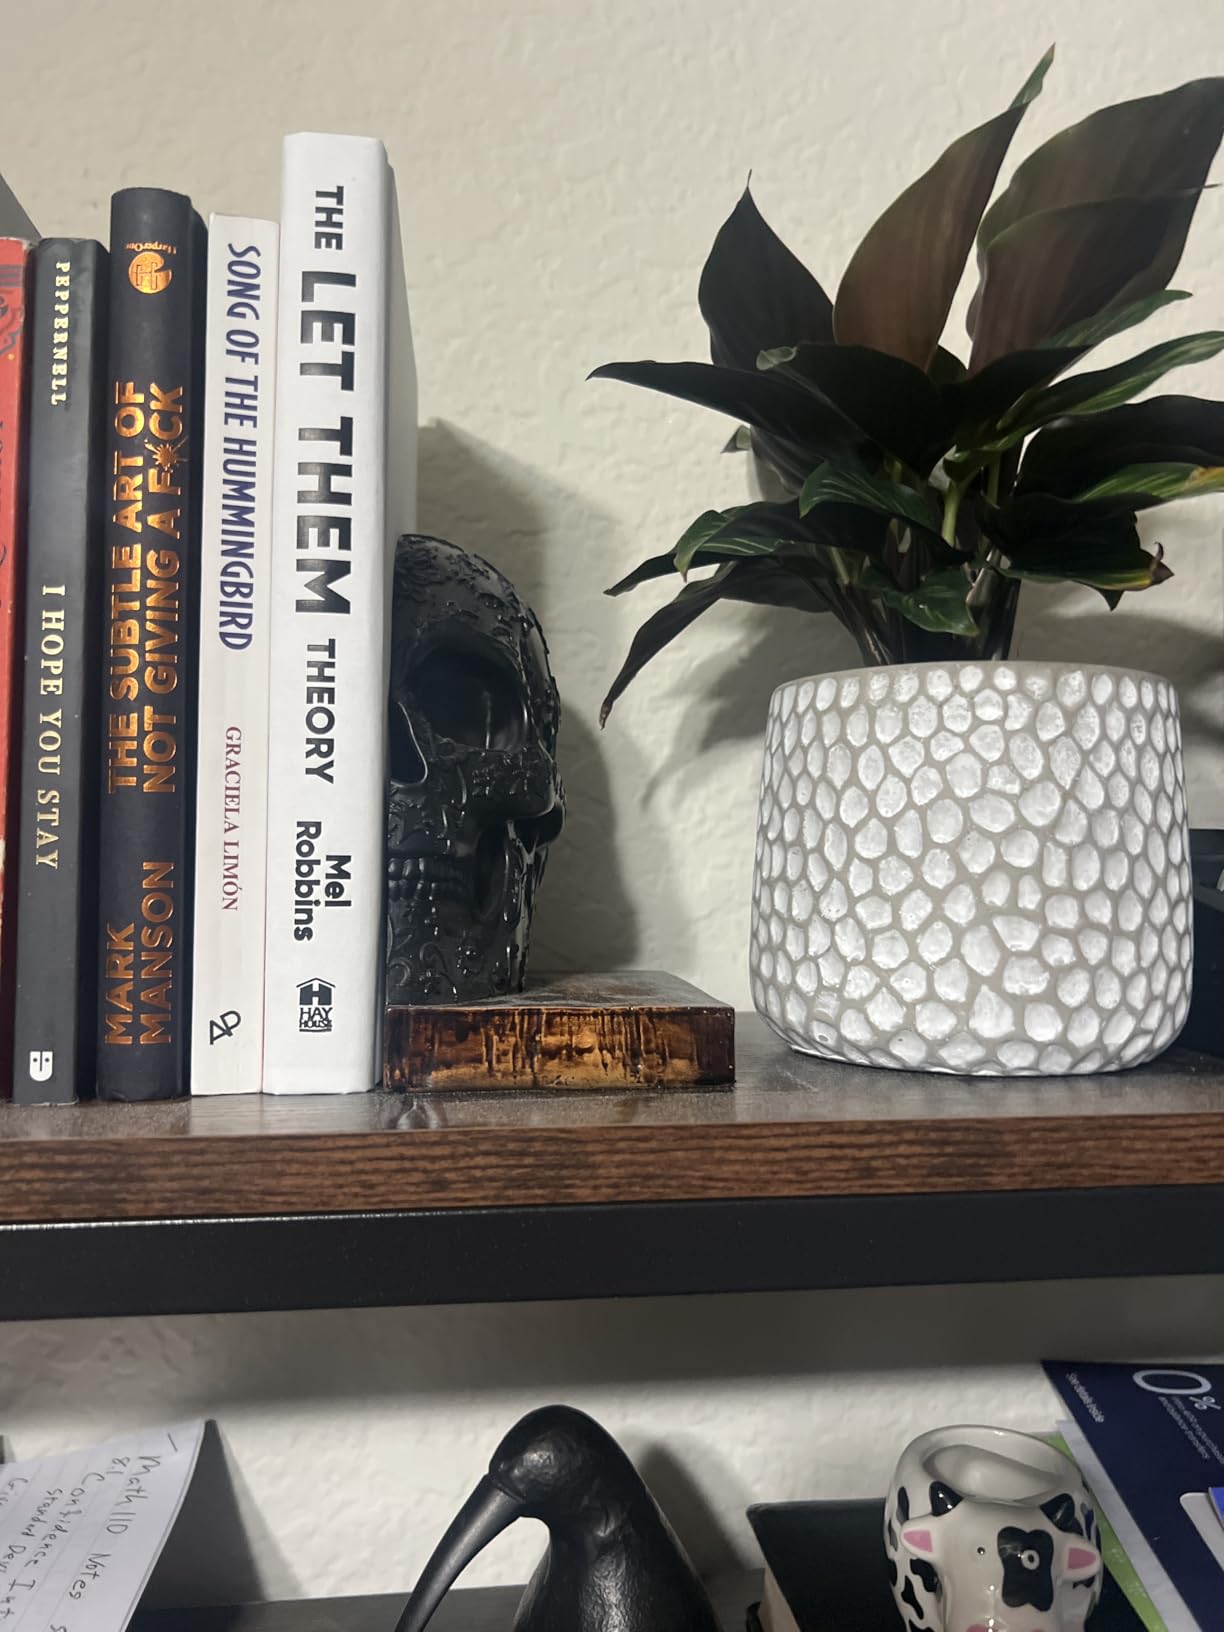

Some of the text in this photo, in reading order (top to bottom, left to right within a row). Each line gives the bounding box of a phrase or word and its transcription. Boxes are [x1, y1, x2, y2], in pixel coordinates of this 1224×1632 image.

[51, 261, 71, 406] PEPPERNELL
[218, 243, 261, 651] SONG OF THE HUMMINGBIRD
[295, 185, 357, 784] THE LET THEM THEORY
[108, 380, 145, 795] THE SUBTLE ART OF
[146, 512, 182, 539] A
[143, 549, 181, 692] GIVING
[35, 585, 65, 870] I HOPE YOU STAY
[142, 705, 177, 793] NOT
[221, 726, 243, 911] GRACIELA LIMÓN
[293, 820, 322, 942] Robbins
[325, 854, 352, 908] Mel
[104, 922, 136, 1046] MARK
[140, 861, 175, 1045] MANSON
[299, 1007, 333, 1020] HAY
[24, 1472, 105, 1567] Confidence
[69, 1456, 161, 1599] Math 110 Notes
